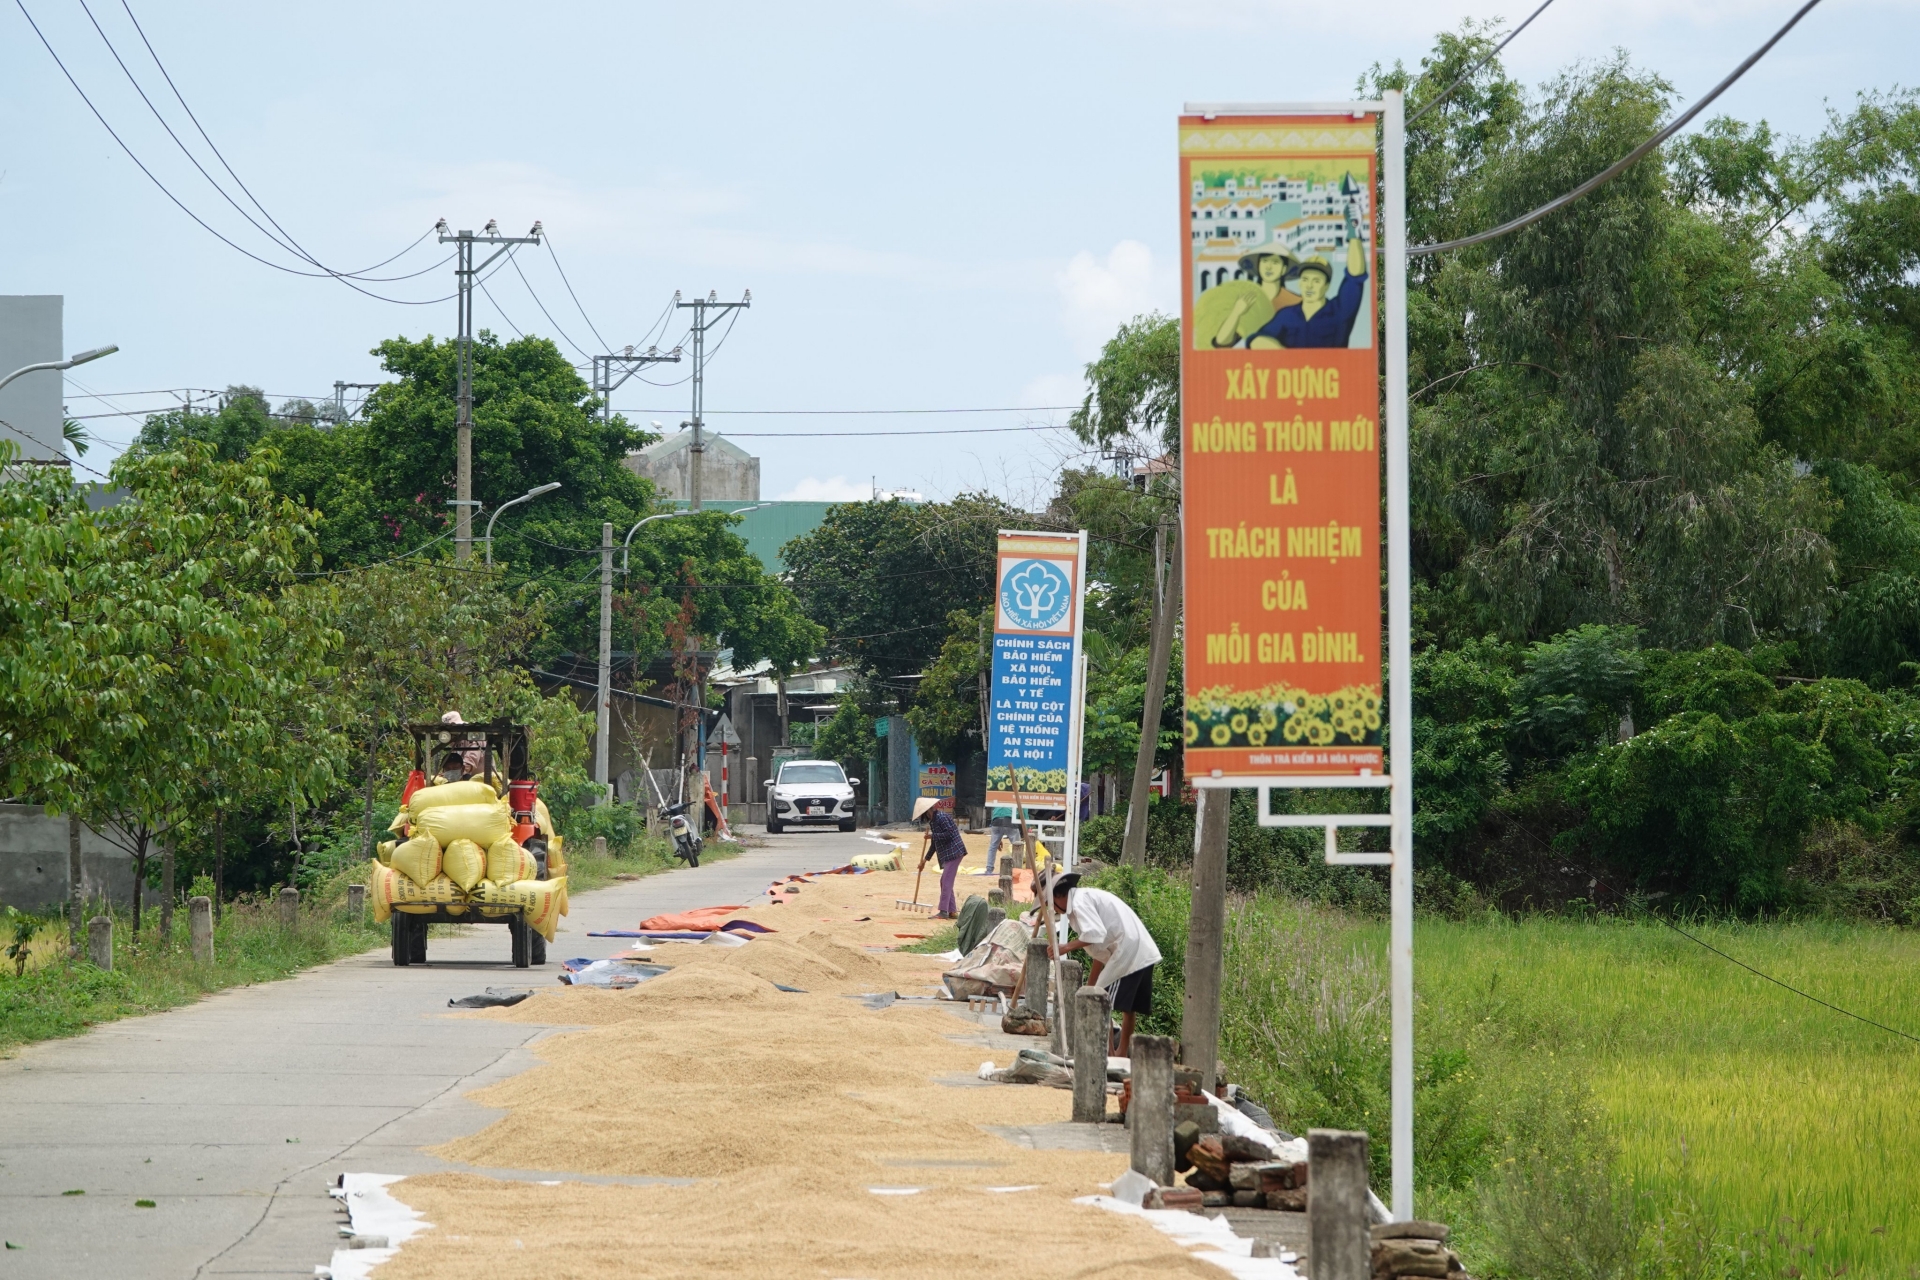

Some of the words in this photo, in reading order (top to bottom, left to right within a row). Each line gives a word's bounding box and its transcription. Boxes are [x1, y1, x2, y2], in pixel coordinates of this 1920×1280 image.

[1226, 362, 1270, 399] XÂY
[1277, 365, 1340, 406] DỰNG
[1192, 416, 1257, 453] NÔNG
[1263, 414, 1323, 452] THÔN
[1330, 414, 1374, 451] MỚI
[1270, 467, 1298, 505] LÀ
[1206, 521, 1280, 558] TRÁCH
[1287, 520, 1362, 564] NHIỆM
[1262, 570, 1308, 611] CỦA
[1059, 595, 1070, 612] NAM
[996, 638, 1034, 648] CHÍNH
[1038, 640, 1070, 650] SÁCH
[1206, 622, 1250, 664] MỖI
[1257, 632, 1296, 664] GIA
[1301, 626, 1365, 663] ĐÌNH.
[1003, 650, 1028, 660] BẢO
[1032, 651, 1062, 662] HIỂM
[1010, 663, 1026, 672] XÃ
[1002, 674, 1026, 684] BẢO
[1030, 675, 1062, 686] HIỂM
[1018, 689, 1026, 697] Y
[1030, 688, 1044, 698] TẾ
[996, 699, 1012, 708] LÀ
[1015, 701, 1038, 711] TRỤ
[1042, 701, 1065, 712] CỘT
[997, 712, 1034, 722] CHÍNH
[1038, 712, 1063, 723] CỦA
[1000, 724, 1015, 734] HỆ
[1019, 724, 1059, 736] THỐNG
[1004, 737, 1021, 746] AN
[1024, 738, 1054, 747] SINH
[1004, 748, 1020, 758] XÃ
[1024, 749, 1044, 760] HỘI
[1249, 753, 1272, 764] THÔN
